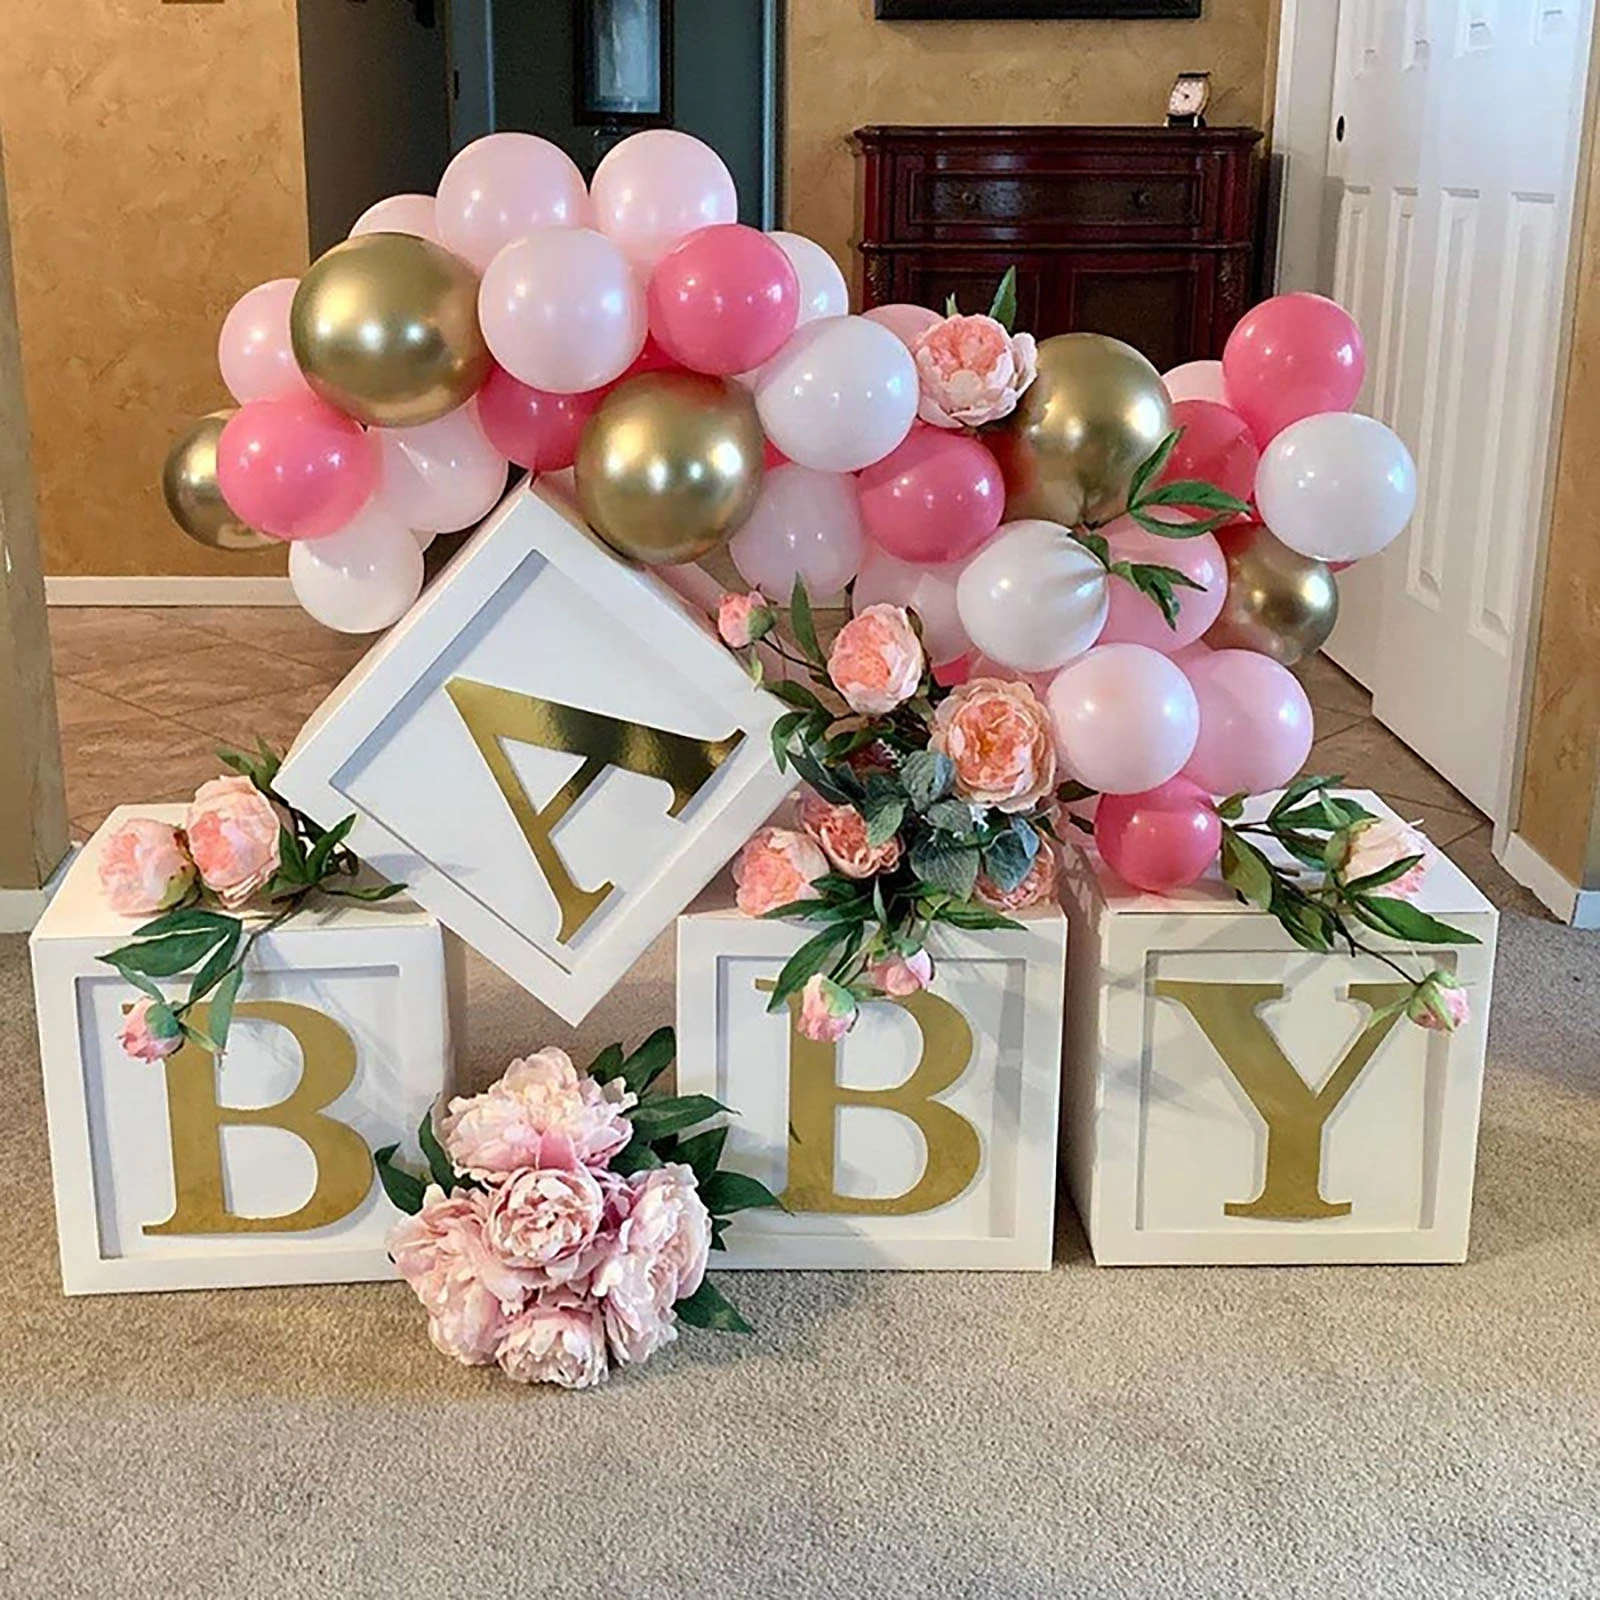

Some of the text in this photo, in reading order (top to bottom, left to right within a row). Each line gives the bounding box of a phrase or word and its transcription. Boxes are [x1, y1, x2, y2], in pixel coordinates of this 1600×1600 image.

[444, 676, 746, 945] A
[121, 1000, 375, 1235] B
[755, 977, 981, 1214] B
[1156, 980, 1415, 1219] Y
